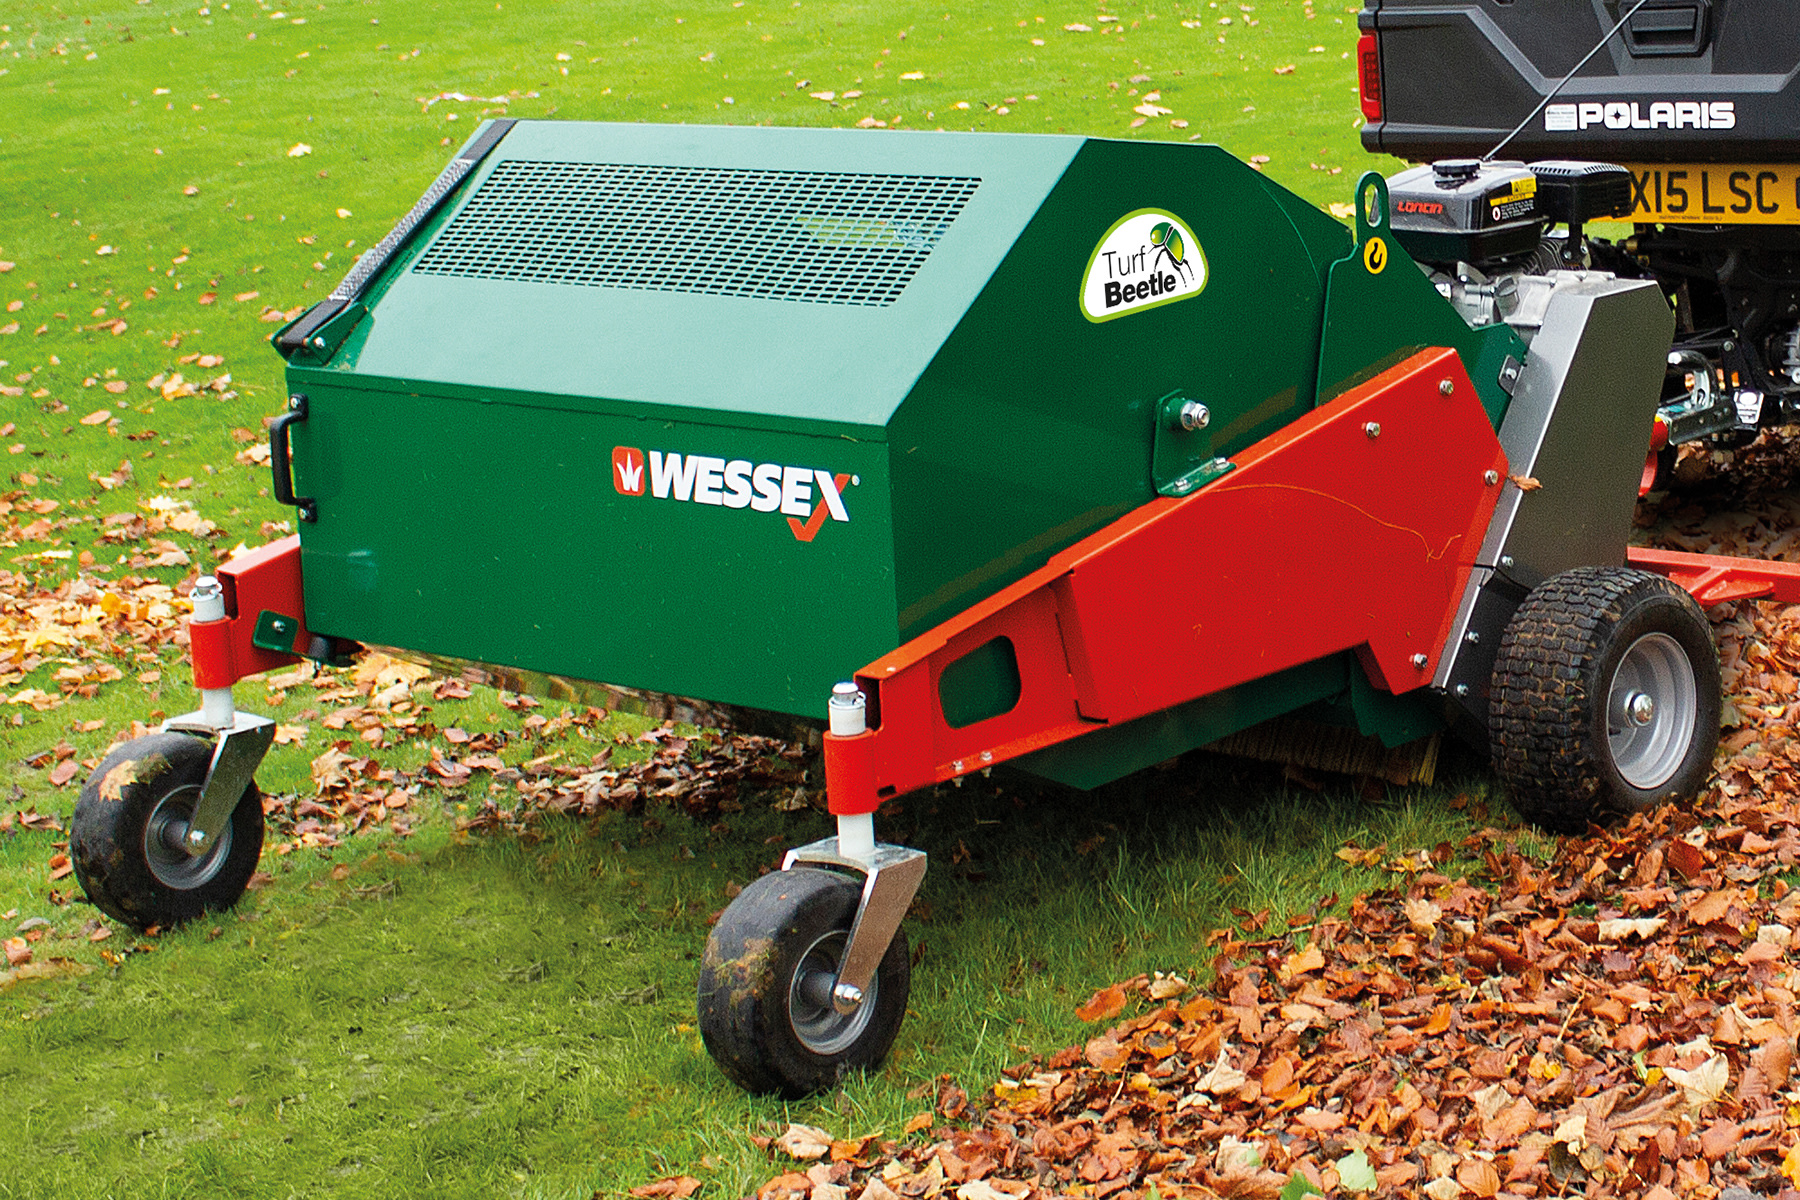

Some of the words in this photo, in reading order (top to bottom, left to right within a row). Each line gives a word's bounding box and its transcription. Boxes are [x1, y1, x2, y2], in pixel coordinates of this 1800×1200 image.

[1578, 102, 1736, 130] POLARIS
[1701, 170, 1780, 214] LSC
[1101, 245, 1147, 279] Turf
[1104, 270, 1177, 309] Beetle
[648, 450, 851, 542] WESSEX
